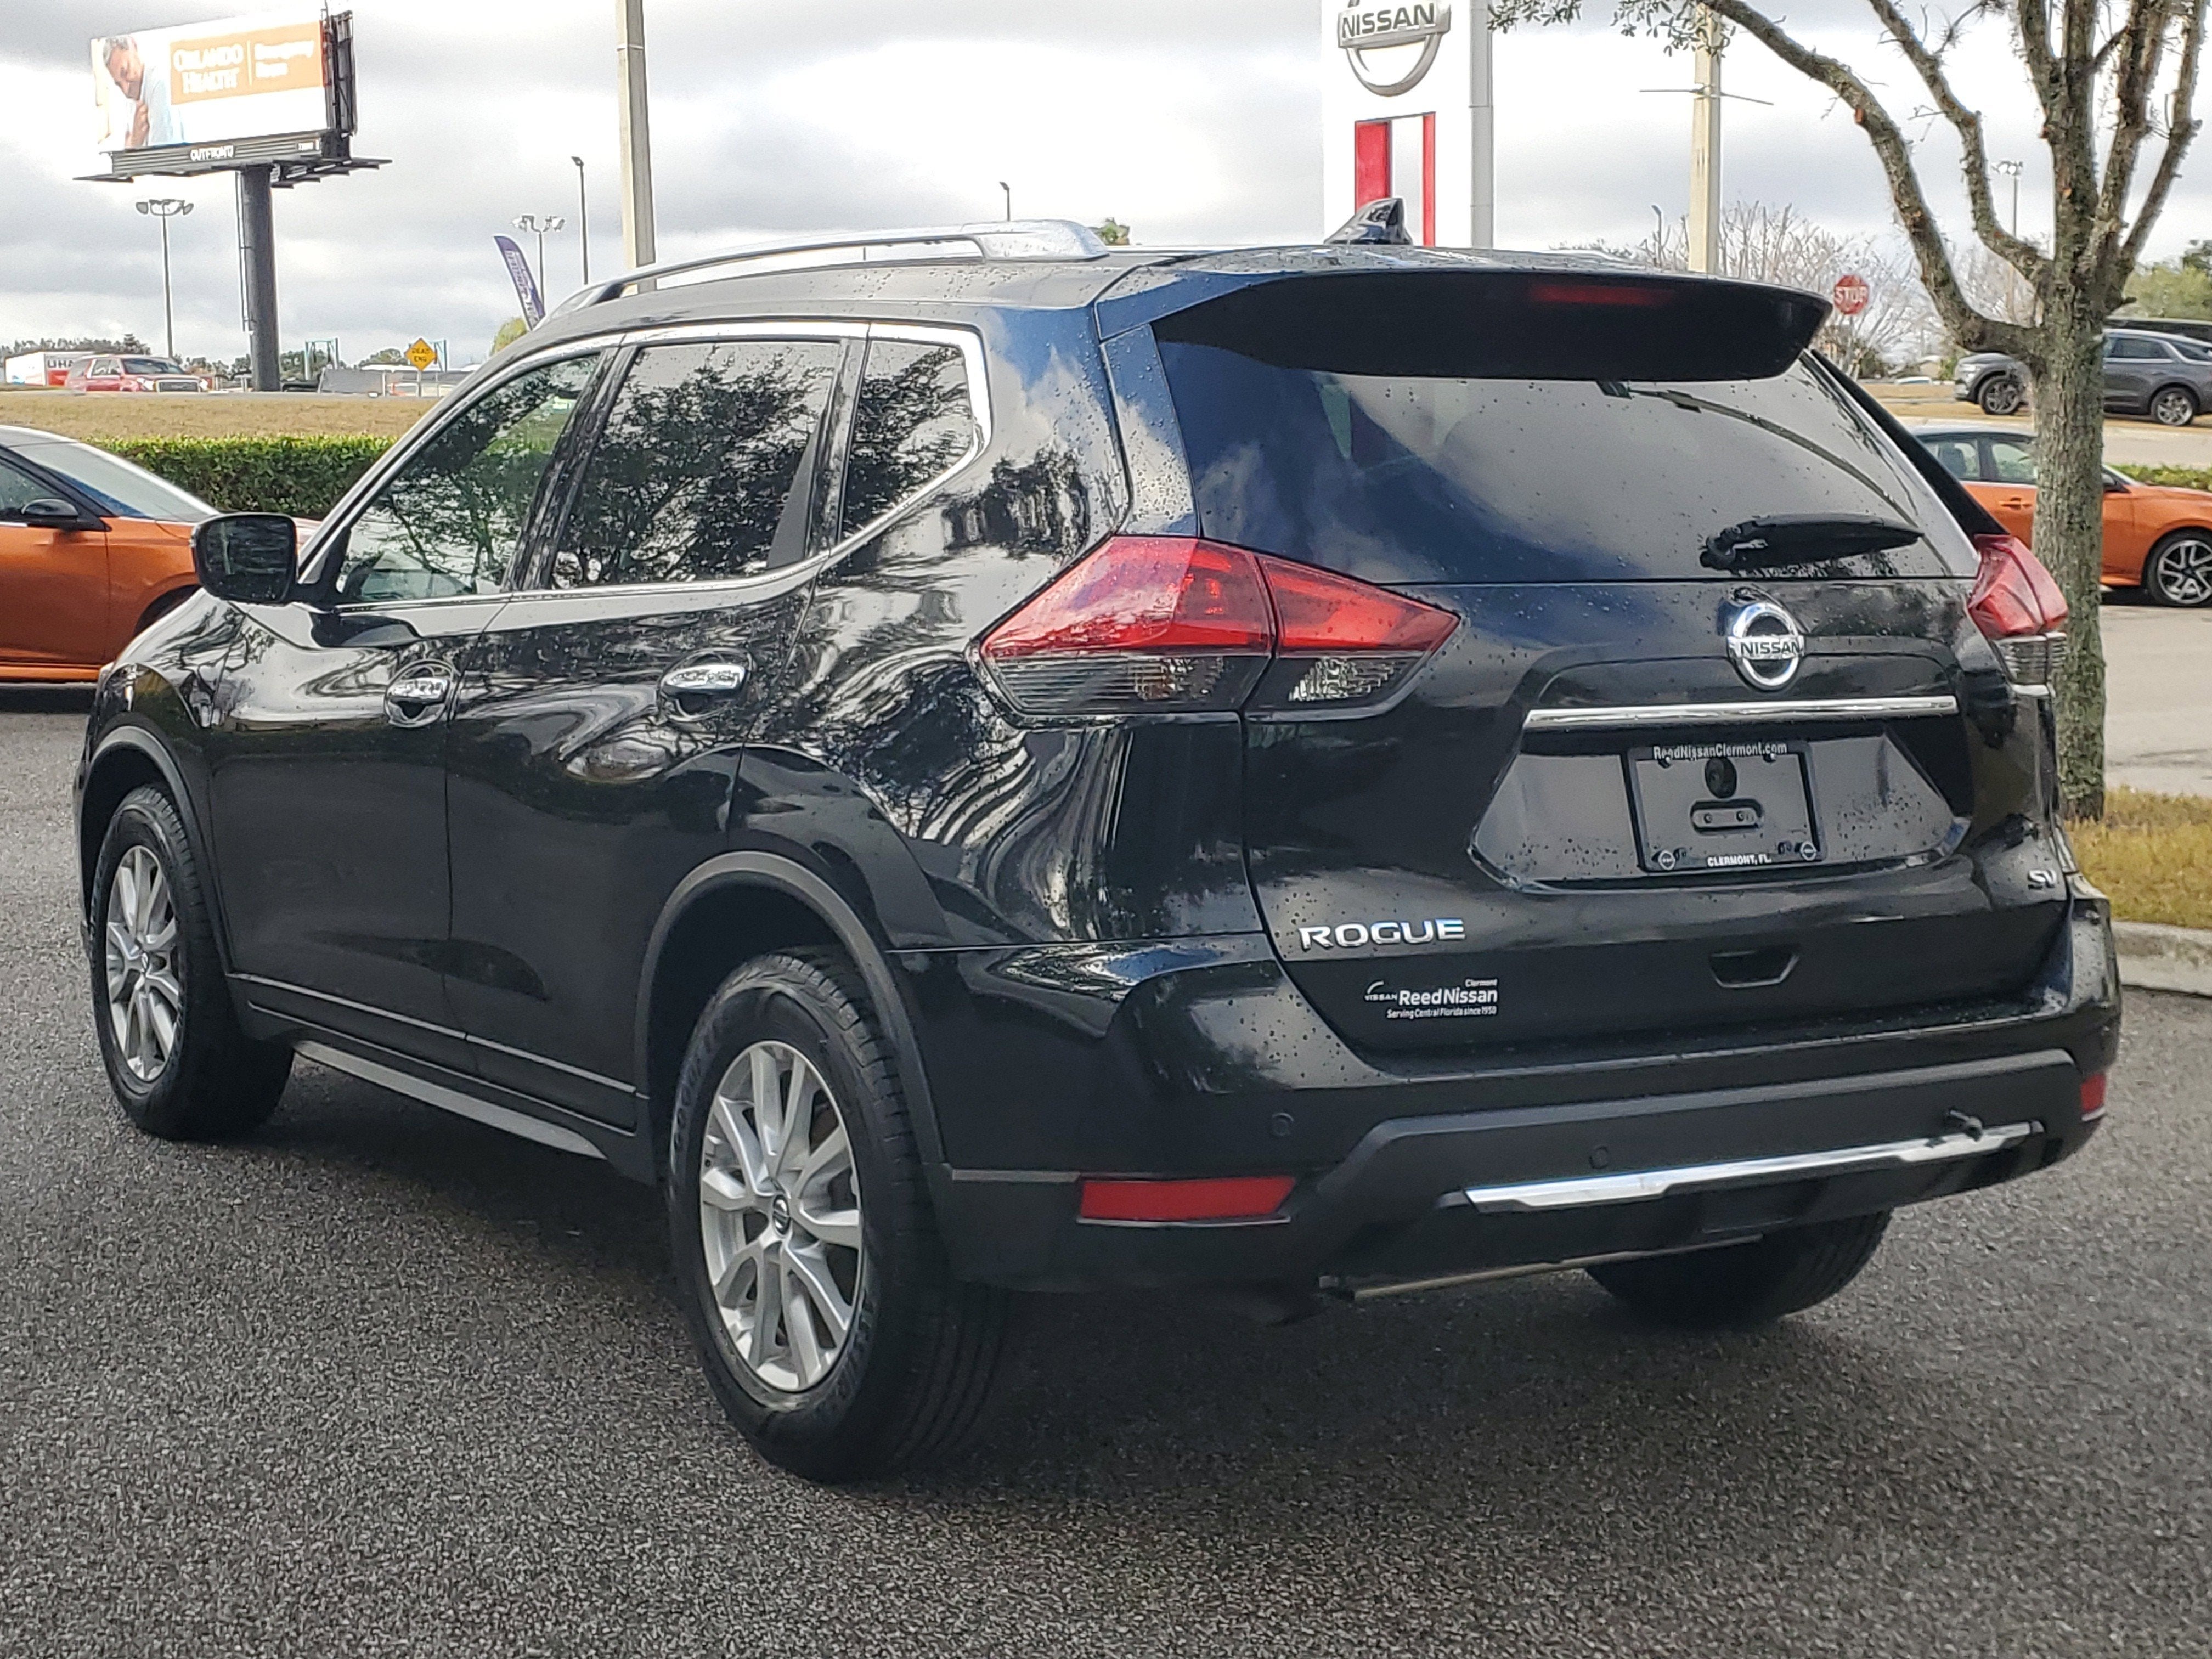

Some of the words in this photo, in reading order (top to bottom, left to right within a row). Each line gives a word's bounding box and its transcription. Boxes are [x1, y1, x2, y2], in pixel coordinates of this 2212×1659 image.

[1342, 3, 1434, 38] NISSAN
[173, 43, 244, 72] ORLANDO
[182, 67, 239, 94] HEALTH
[1835, 286, 1867, 303] STOP
[1741, 641, 1801, 656] NISSAN
[1298, 919, 1466, 950] ROGUE
